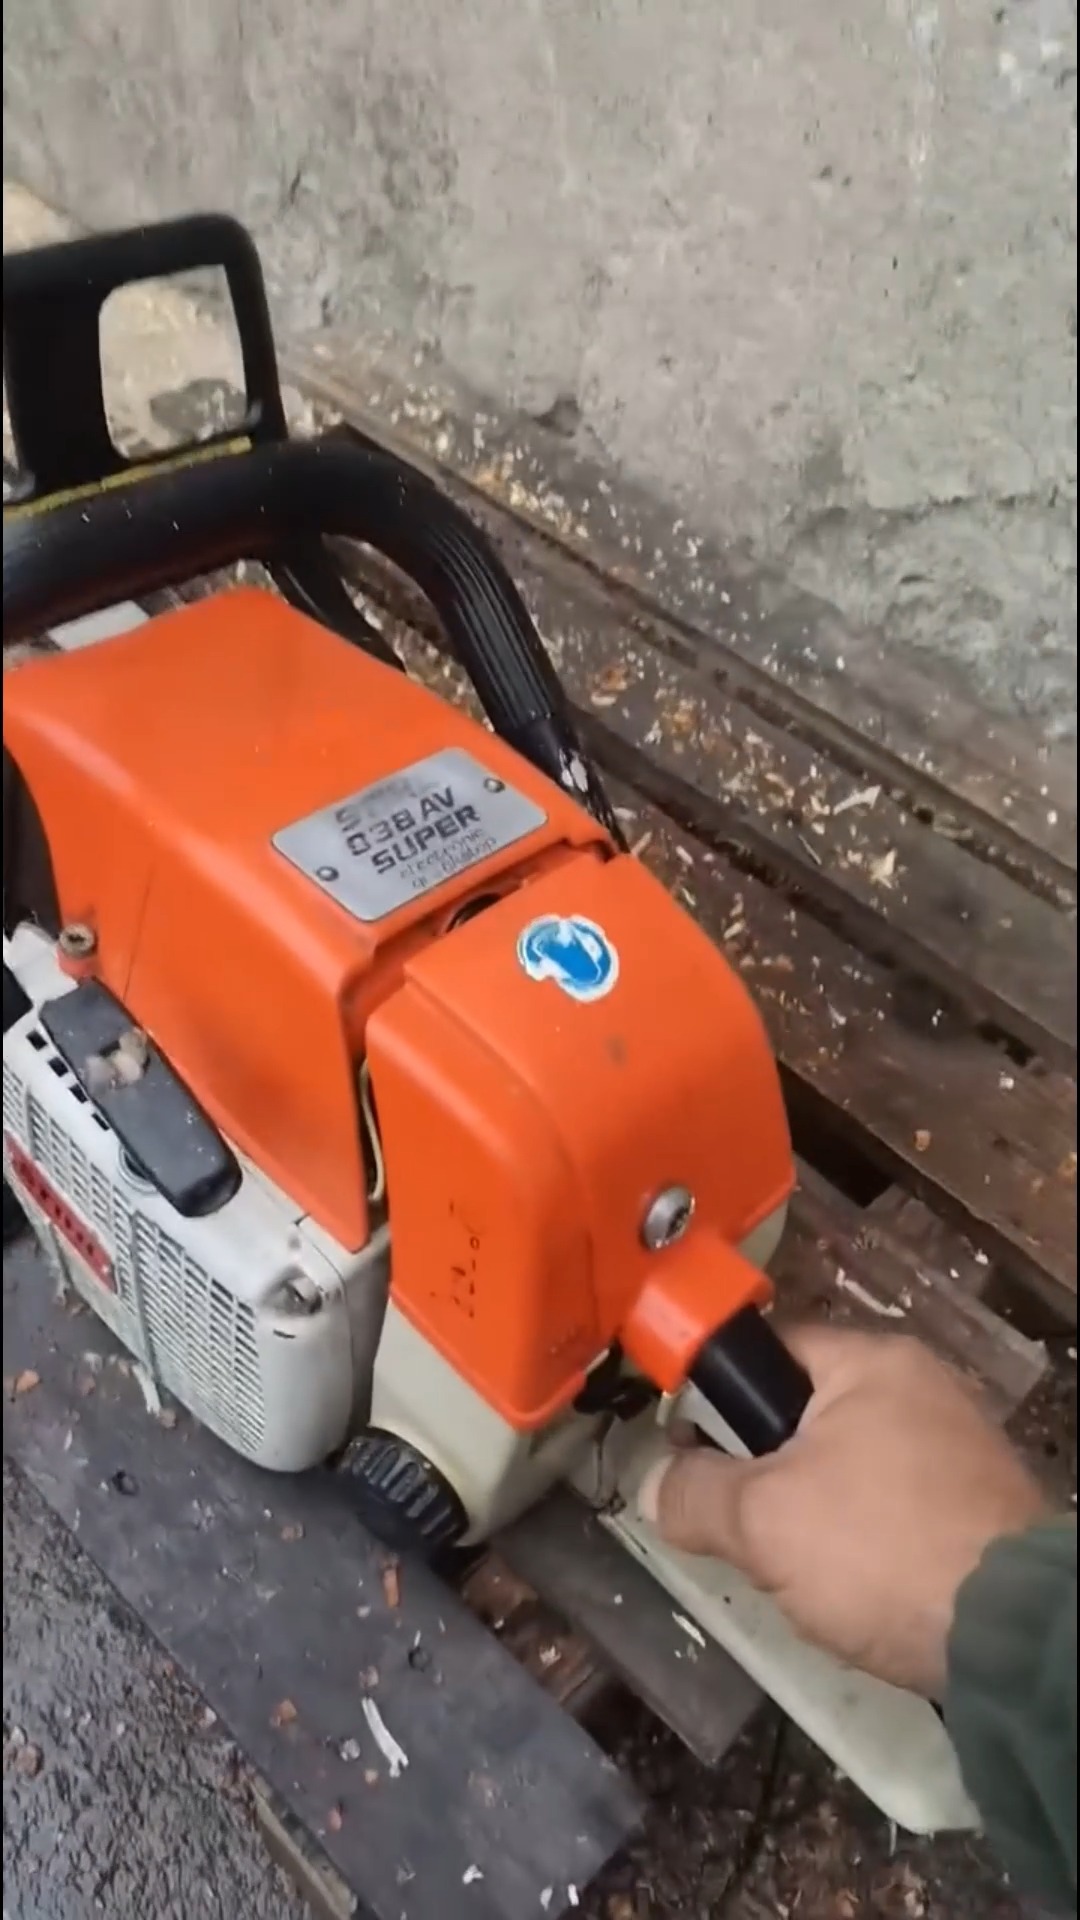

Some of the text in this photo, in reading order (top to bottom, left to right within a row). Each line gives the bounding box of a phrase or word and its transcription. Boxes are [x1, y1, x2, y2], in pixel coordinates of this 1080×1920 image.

[347, 808, 416, 856] 038
[419, 786, 455, 821] AV
[371, 804, 481, 874] SUPER
